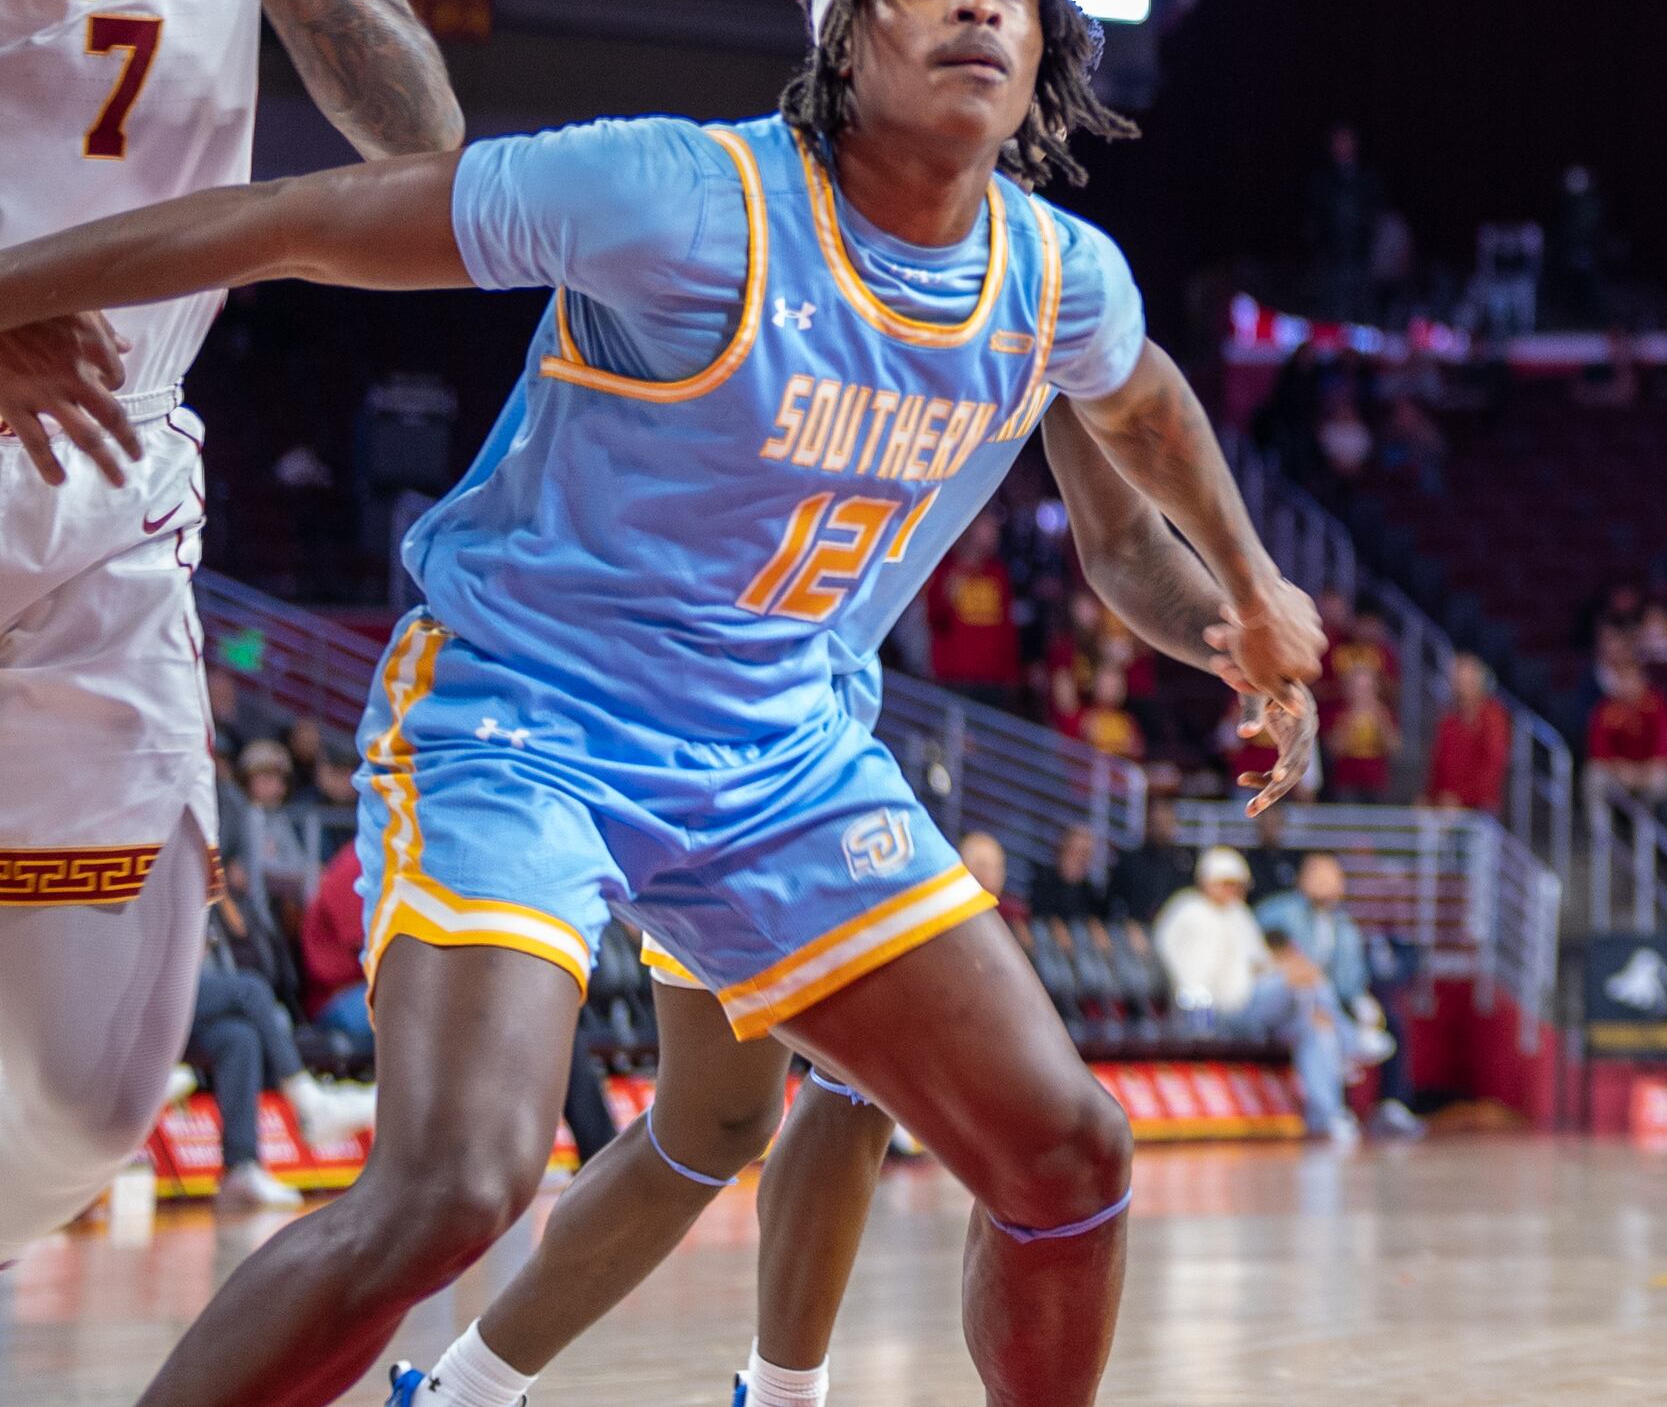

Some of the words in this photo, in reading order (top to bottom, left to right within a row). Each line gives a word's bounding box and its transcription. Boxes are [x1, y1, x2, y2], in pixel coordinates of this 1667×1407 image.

[82, 13, 165, 161] 7
[759, 373, 998, 483] SOUTHERN
[734, 491, 904, 624] 12
